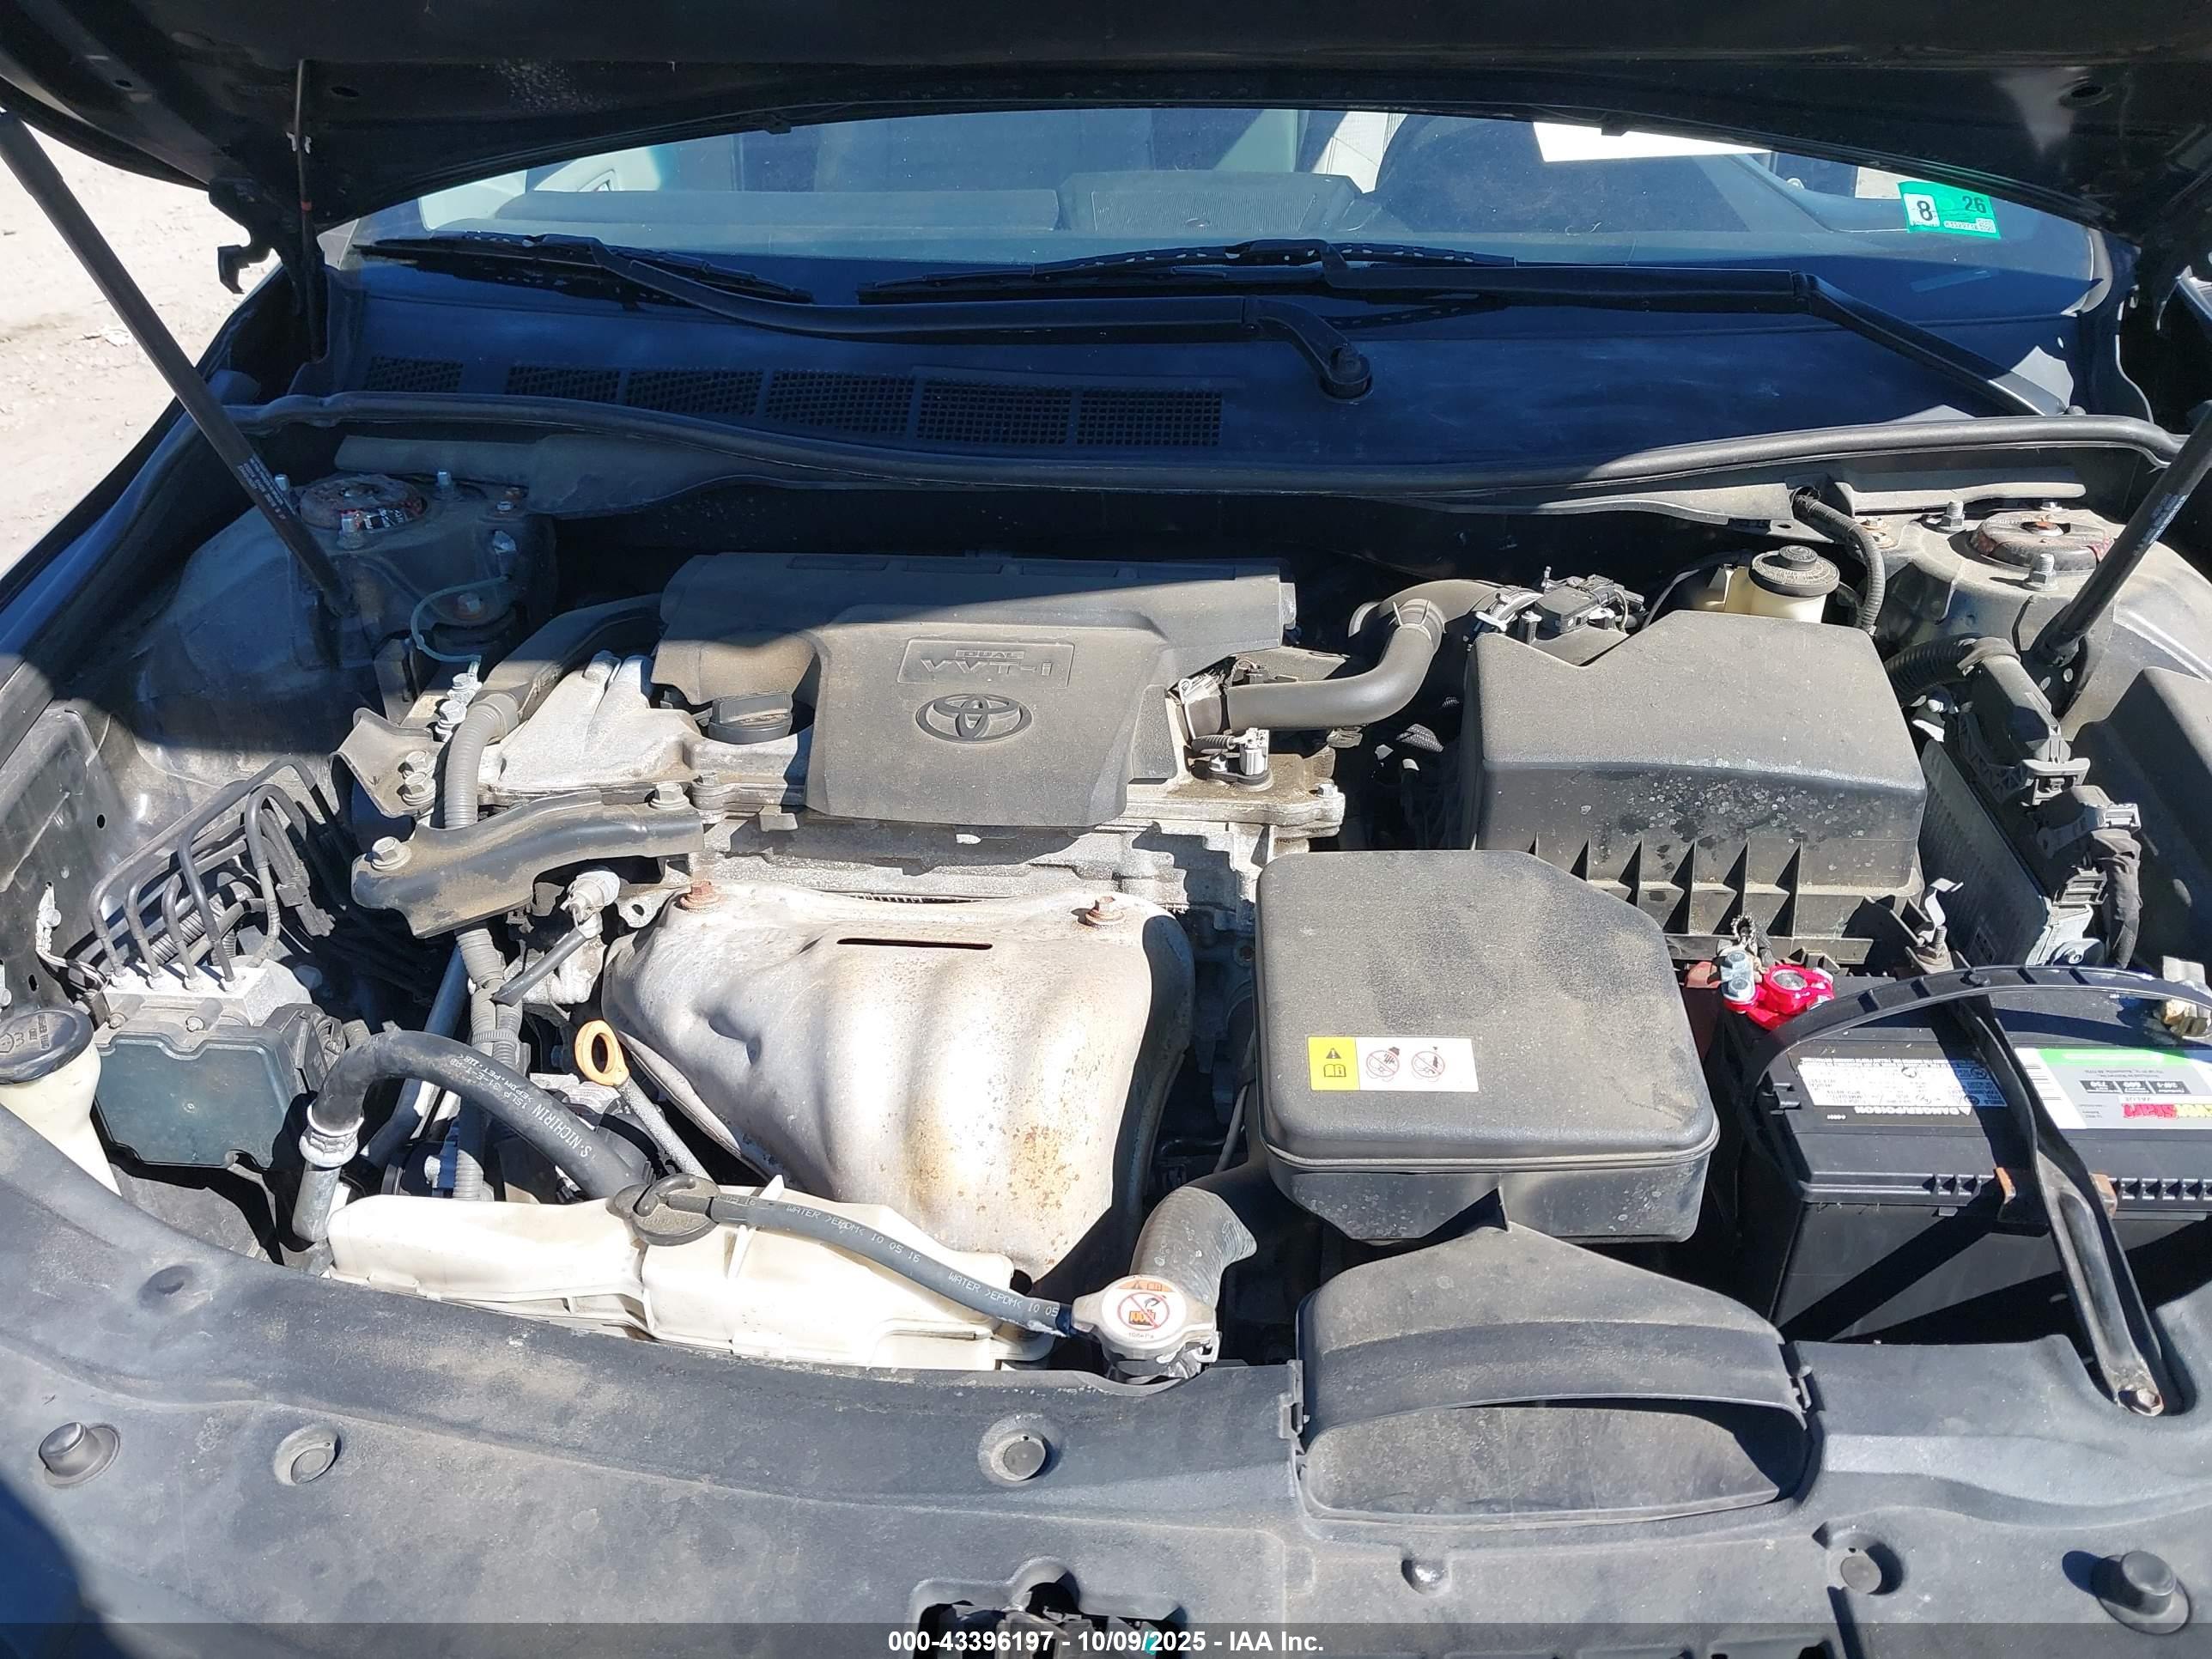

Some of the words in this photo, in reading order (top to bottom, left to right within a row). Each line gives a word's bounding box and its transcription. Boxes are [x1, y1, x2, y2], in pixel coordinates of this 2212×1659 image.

[1917, 200, 1933, 222] 8
[1961, 195, 1987, 214] 26
[786, 1204, 822, 1219] WATER
[871, 1232, 884, 1244] 10
[888, 1242, 904, 1255] 05
[908, 1253, 921, 1263] 16
[947, 1271, 981, 1293] WATER
[1028, 1302, 1041, 1314] 10
[1044, 1305, 1060, 1317] 05
